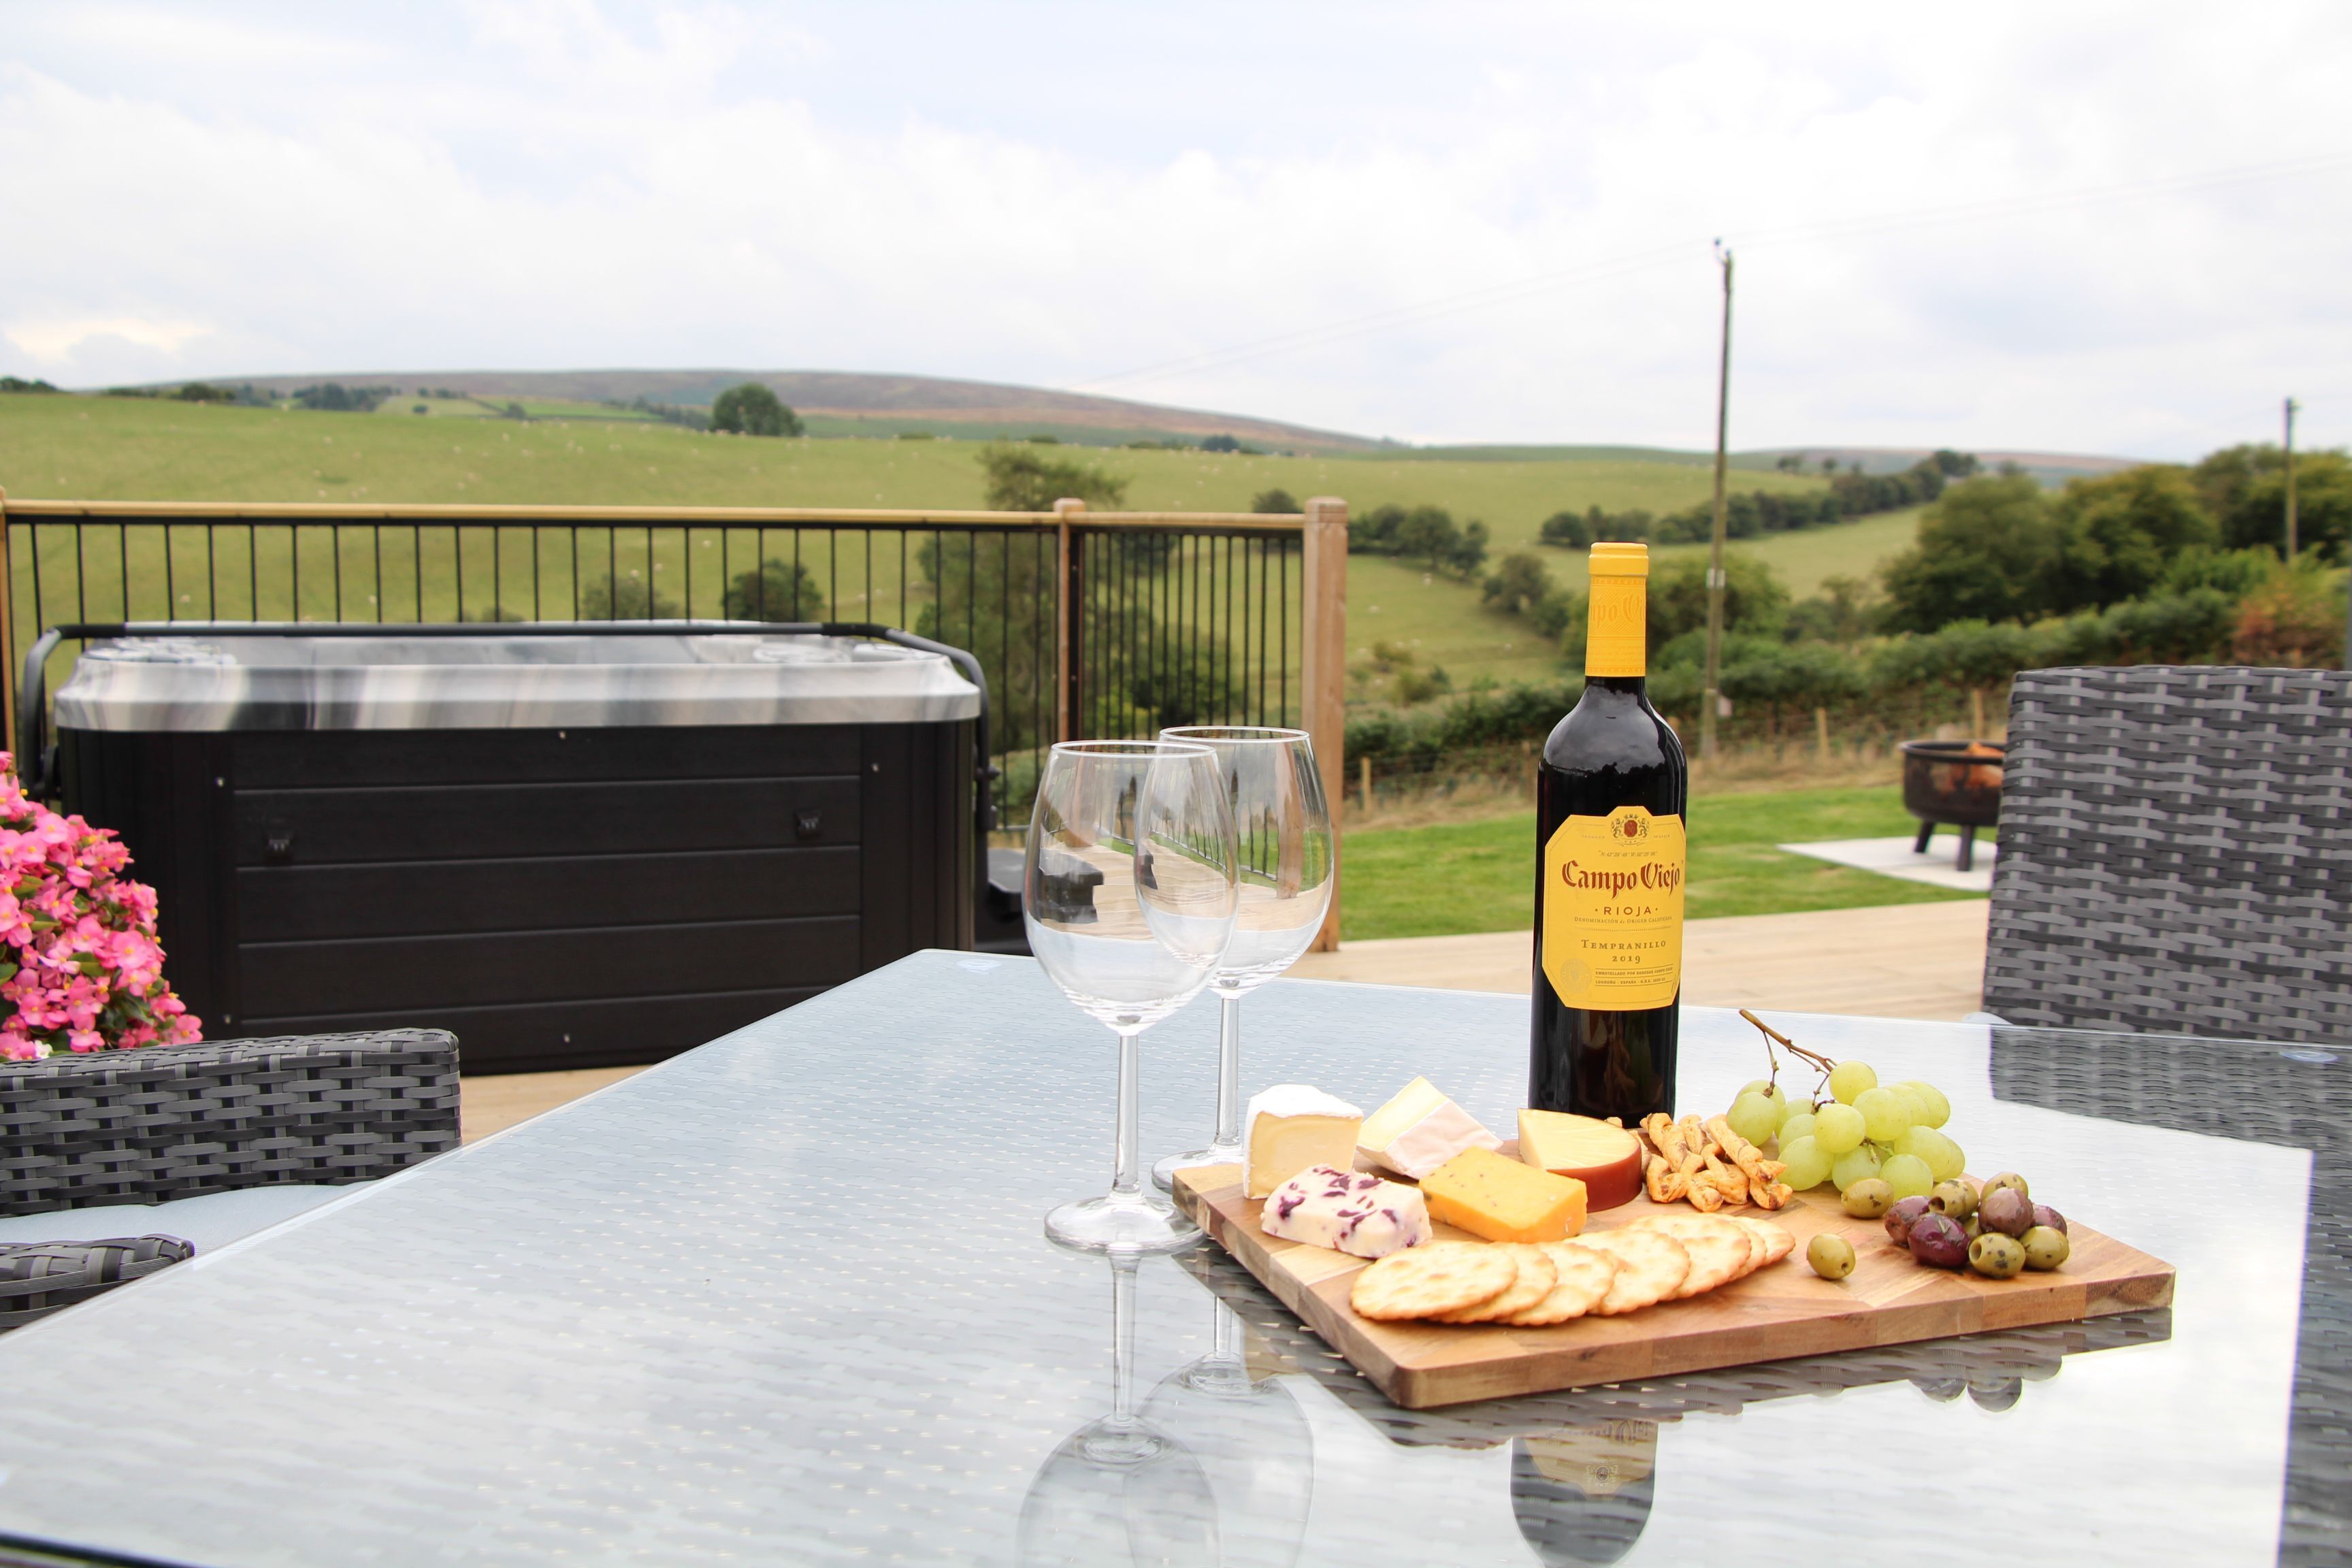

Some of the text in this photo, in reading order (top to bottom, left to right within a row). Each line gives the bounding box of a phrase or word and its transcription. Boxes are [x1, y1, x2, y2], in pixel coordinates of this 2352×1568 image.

[1562, 860, 1681, 900] Campo Viejo
[1603, 906, 1652, 917] RIOJA
[1581, 938, 1667, 950] TEMPRANILLO
[1612, 955, 1642, 964] 2019
